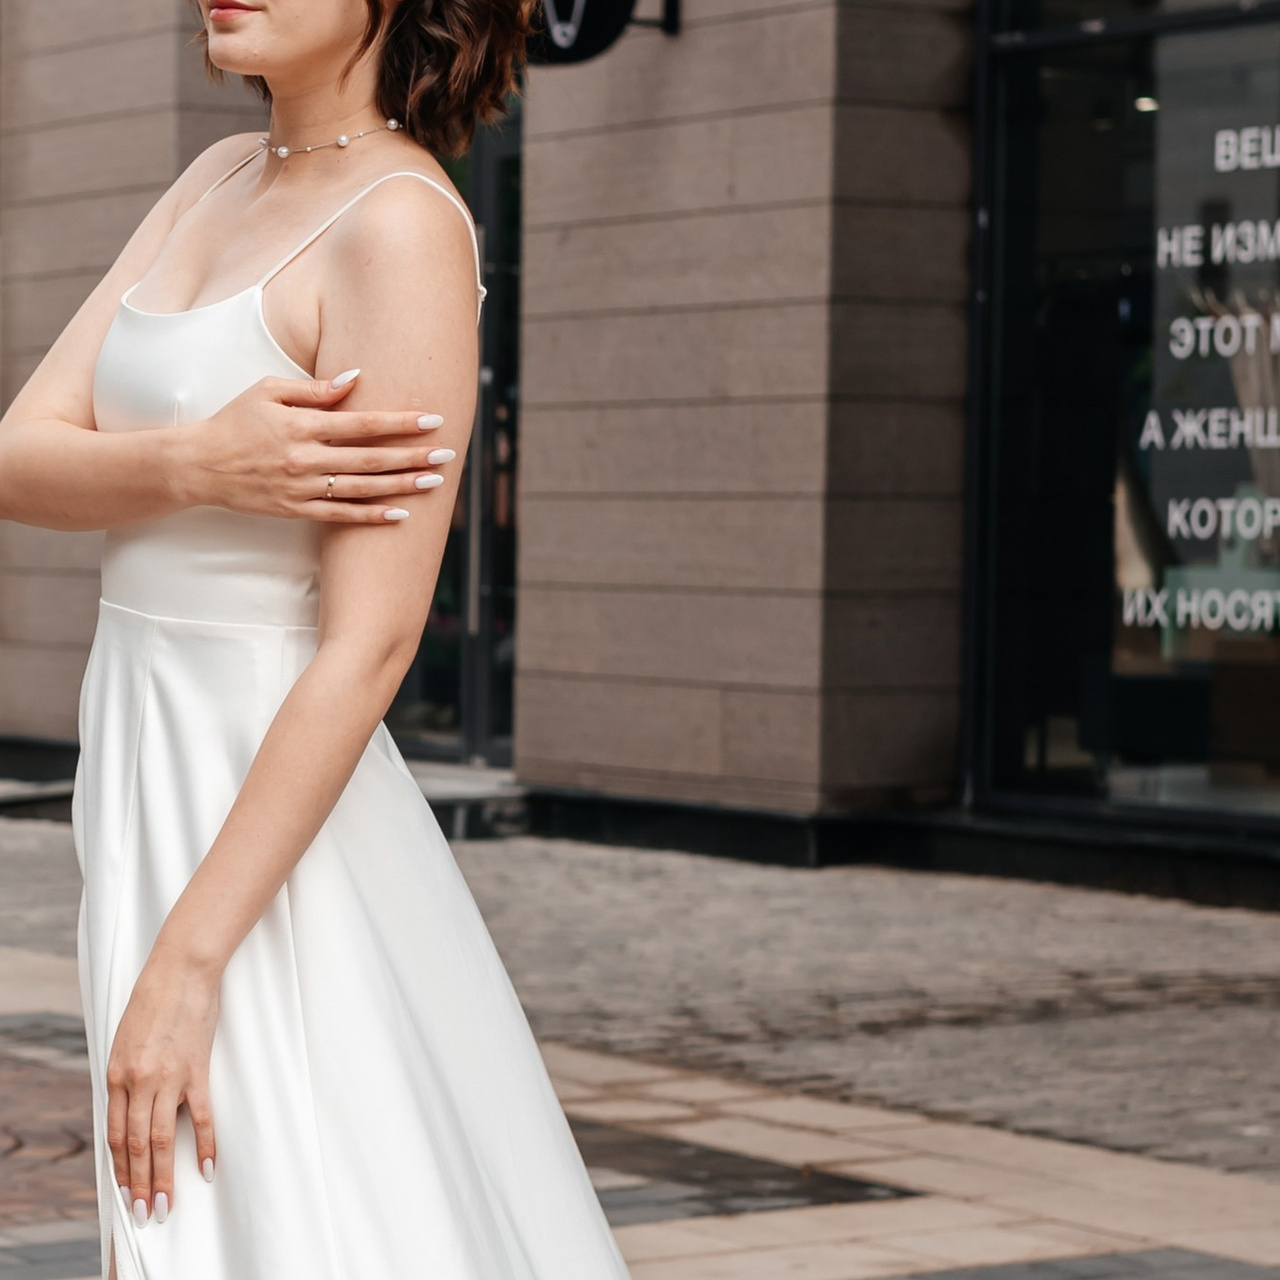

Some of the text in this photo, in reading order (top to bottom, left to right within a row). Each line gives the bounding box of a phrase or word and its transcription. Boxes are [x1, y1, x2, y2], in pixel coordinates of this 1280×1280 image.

[1157, 224, 1204, 269] НЕ
[1169, 313, 1263, 360] ЭТОТ
[1139, 410, 1166, 451] А
[1167, 497, 1280, 540] КОТОР
[1122, 588, 1169, 627] ИХ
